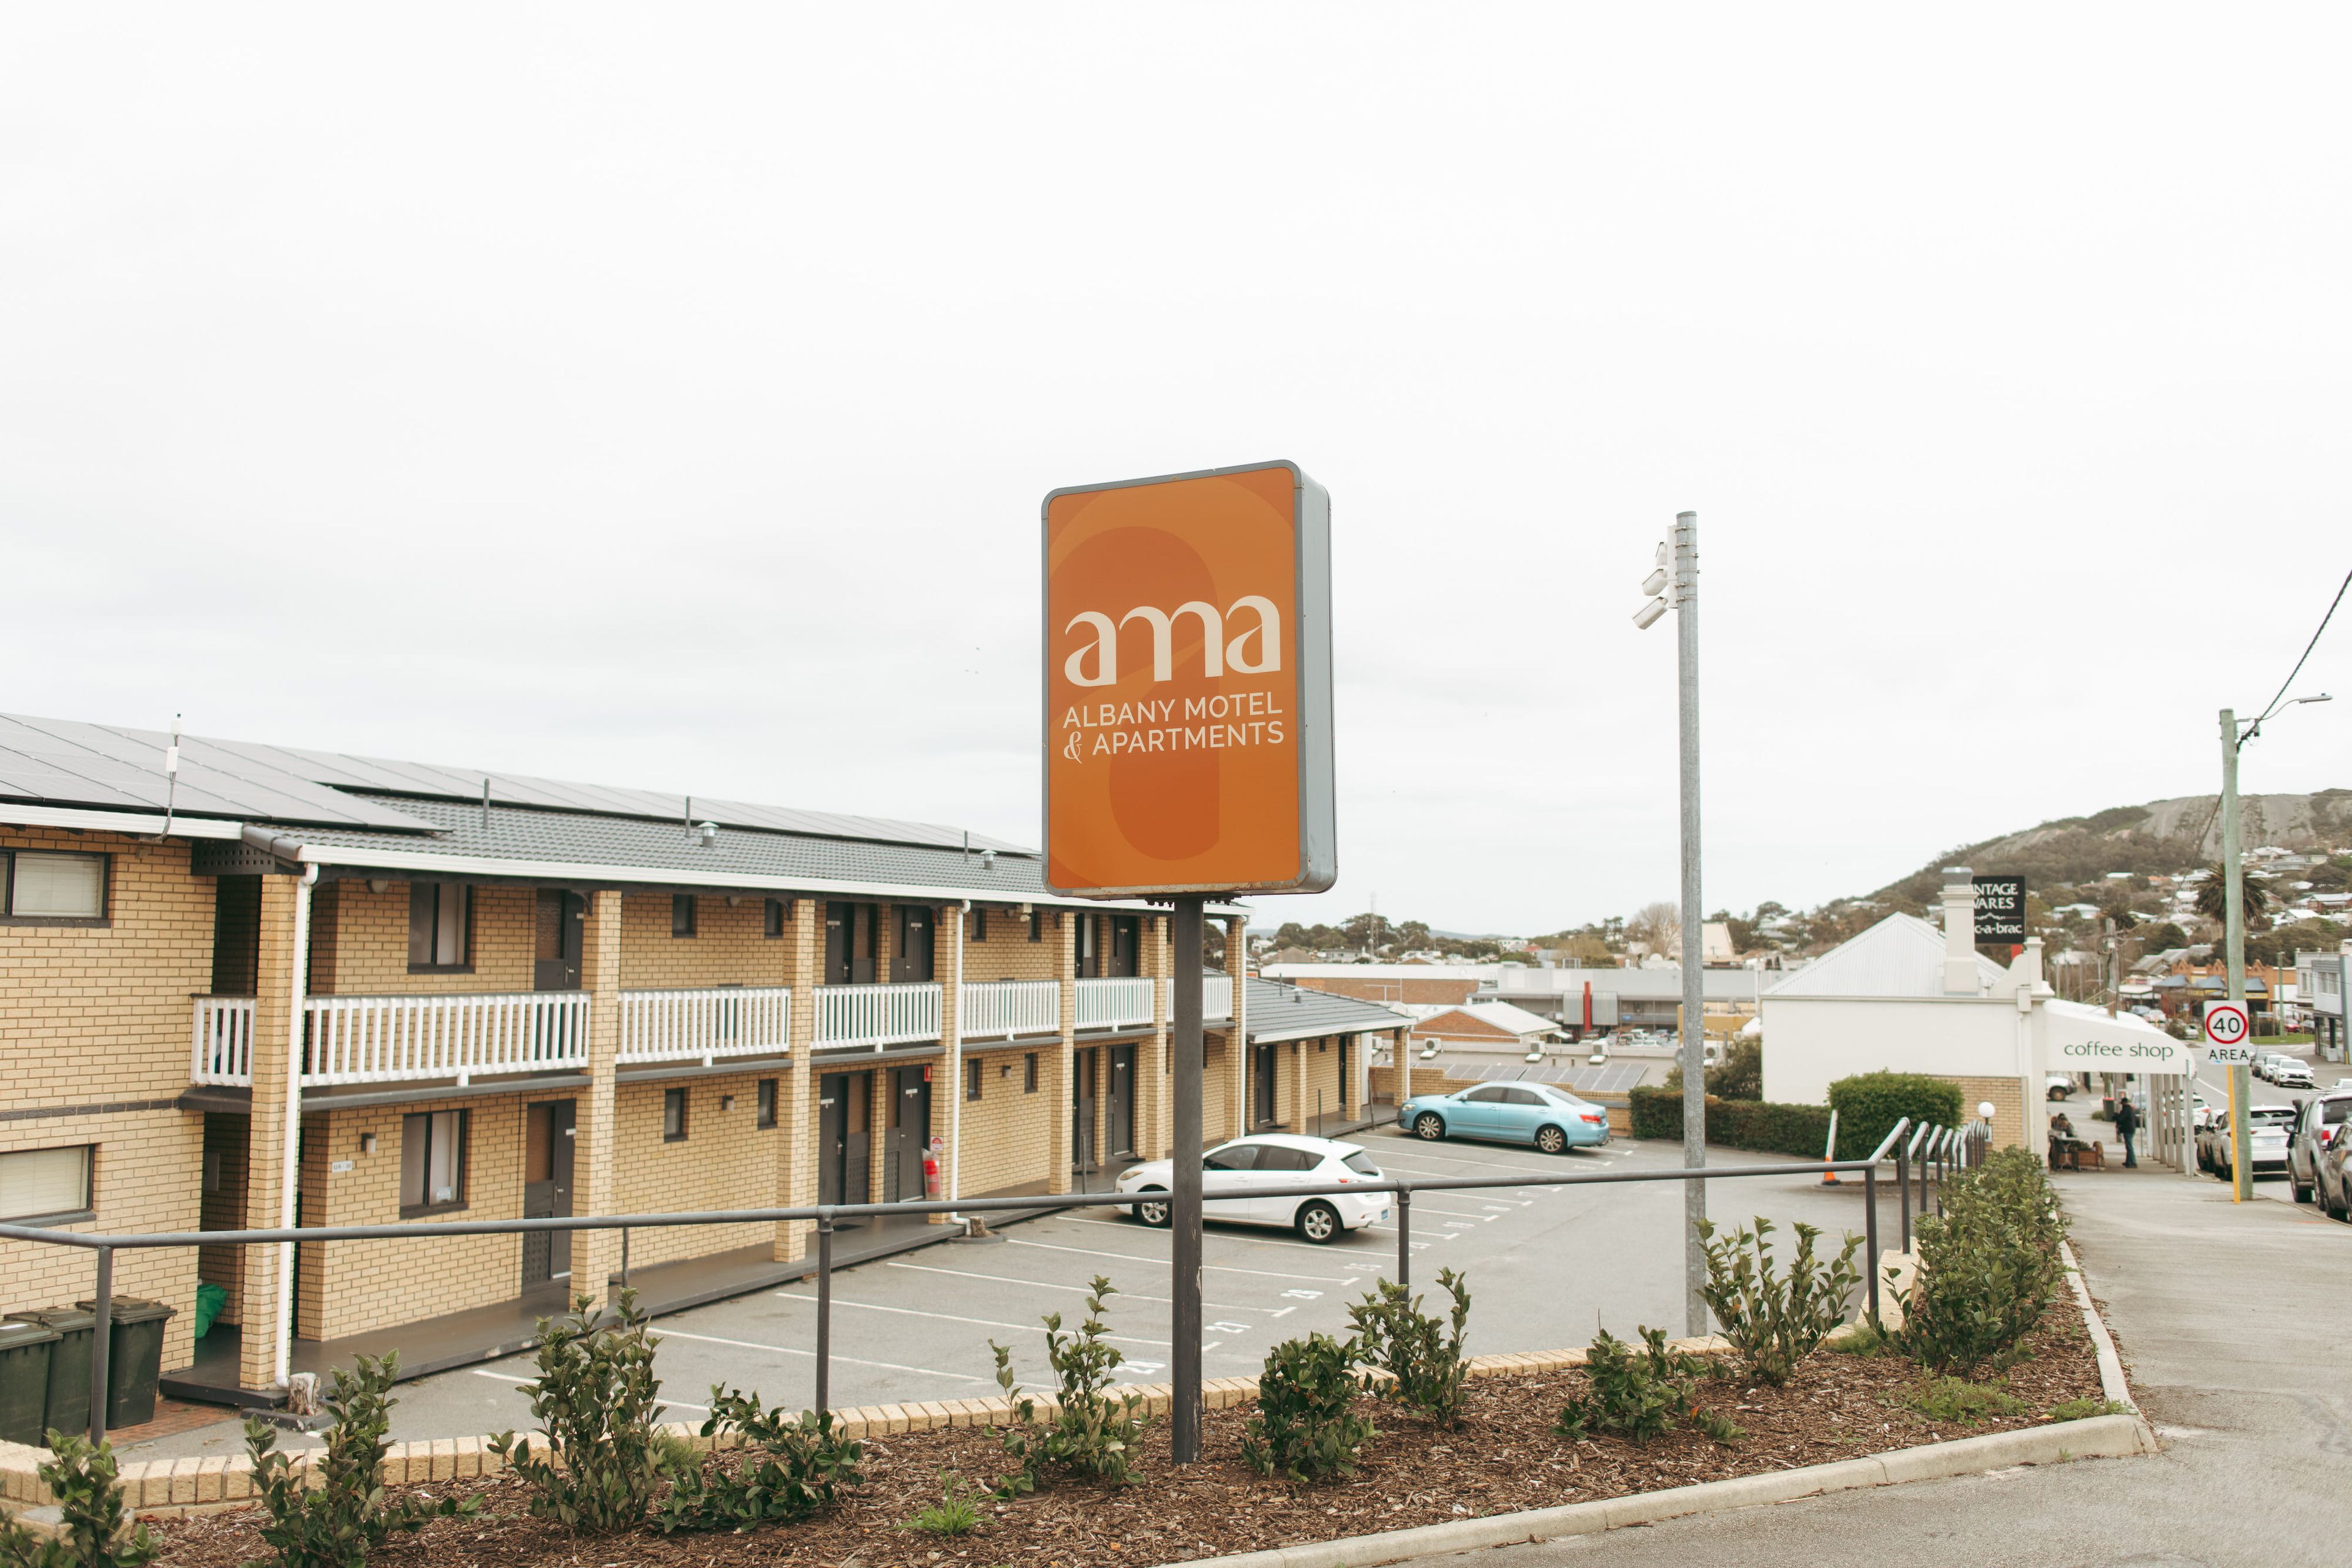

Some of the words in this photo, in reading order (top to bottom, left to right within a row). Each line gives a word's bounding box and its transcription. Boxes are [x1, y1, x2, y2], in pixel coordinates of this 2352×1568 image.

[1065, 595, 1281, 687] ama
[1063, 699, 1175, 728] ALBANY
[1185, 692, 1283, 720] MOTEL
[1063, 731, 1082, 764] &
[1092, 721, 1284, 755] APARTMENTS
[1972, 883, 2018, 895] NTAGE
[1974, 922, 2022, 934] c-a-brac
[2213, 1017, 2240, 1033] 40
[2064, 1041, 2122, 1056] coffee
[2130, 1042, 2174, 1061] shop
[2209, 1049, 2248, 1060] AREA
[1204, 1321, 1252, 1333] 27
